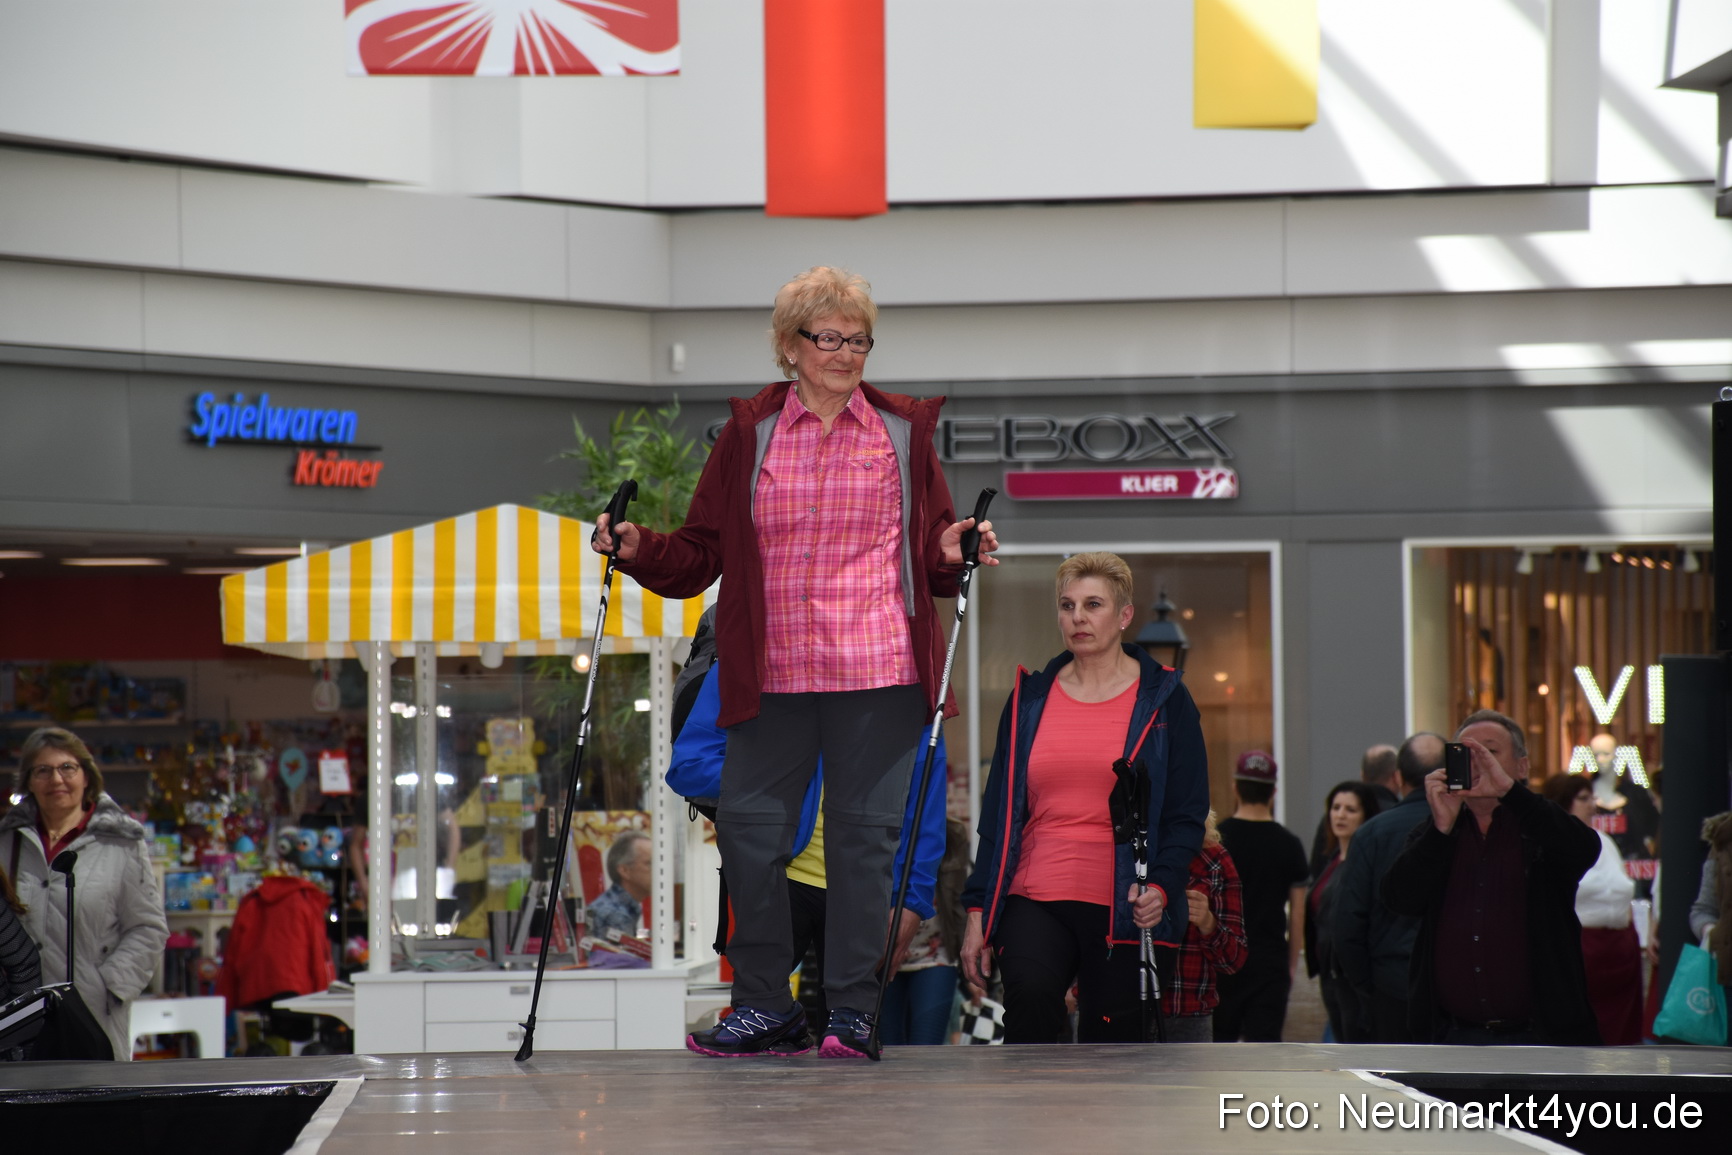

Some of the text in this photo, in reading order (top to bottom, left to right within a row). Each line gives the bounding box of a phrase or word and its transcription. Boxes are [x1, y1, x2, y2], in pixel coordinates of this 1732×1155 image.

[191, 391, 358, 447] Spielwaren
[294, 449, 384, 488] Krömer
[1121, 475, 1179, 493] KLIER
